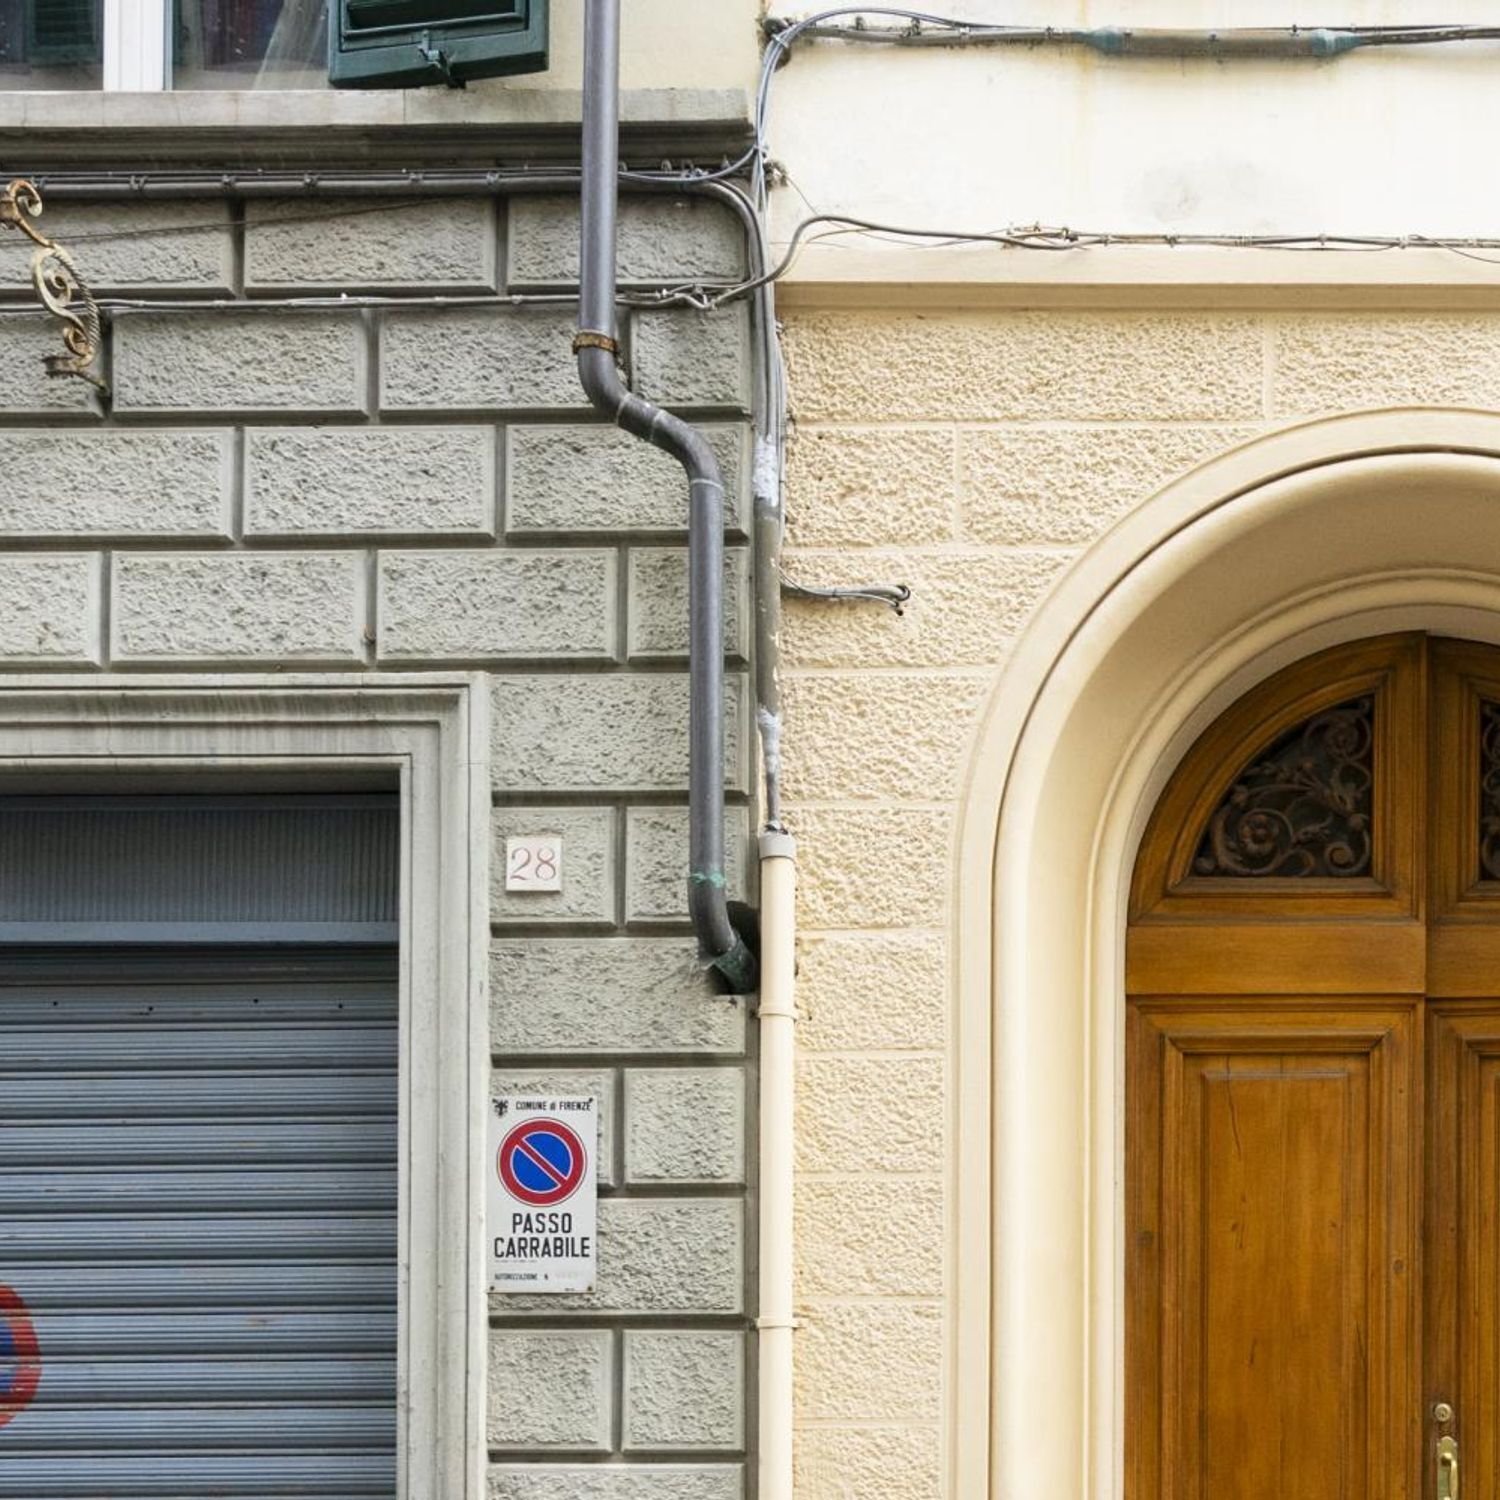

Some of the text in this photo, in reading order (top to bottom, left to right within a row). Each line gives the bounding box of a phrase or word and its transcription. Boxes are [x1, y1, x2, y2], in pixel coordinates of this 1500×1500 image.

[509, 846, 557, 881] 28
[515, 1101, 547, 1111] COMUNE
[559, 1101, 591, 1111] FIRENZE
[512, 1213, 573, 1234] PASSO
[494, 1237, 590, 1258] CARRABILE
